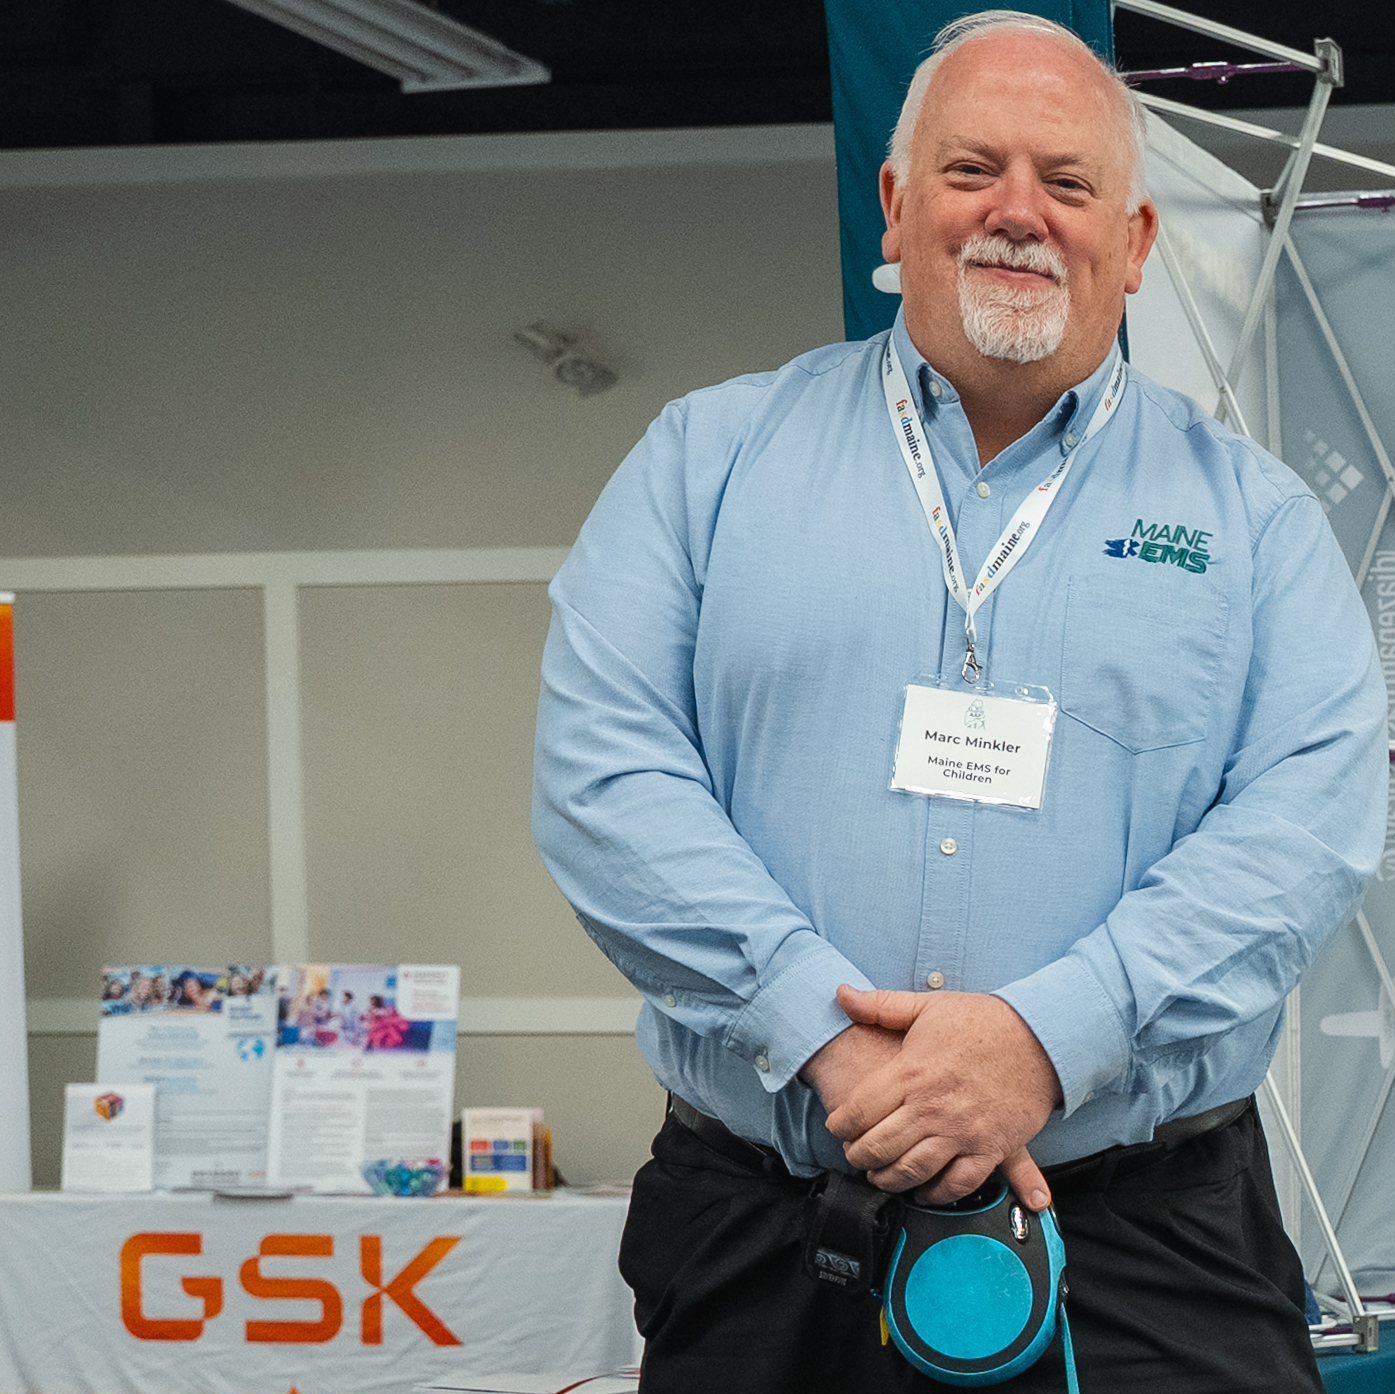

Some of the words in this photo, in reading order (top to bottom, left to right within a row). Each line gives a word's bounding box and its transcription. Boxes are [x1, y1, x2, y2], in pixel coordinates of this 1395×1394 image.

[895, 398, 926, 479] fasdmaine.org
[931, 506, 960, 593] fasdmaine.org
[1130, 518, 1213, 553] MAINE
[975, 520, 1031, 596] fasdmaine.org
[1138, 540, 1210, 574] EMS
[924, 729, 961, 745] Marc
[965, 736, 1021, 753] Minkler
[927, 755, 963, 769] Maine
[966, 761, 991, 773] EMS
[994, 765, 1011, 776] for
[942, 768, 992, 784] Children
[119, 1231, 464, 1348] GSK
